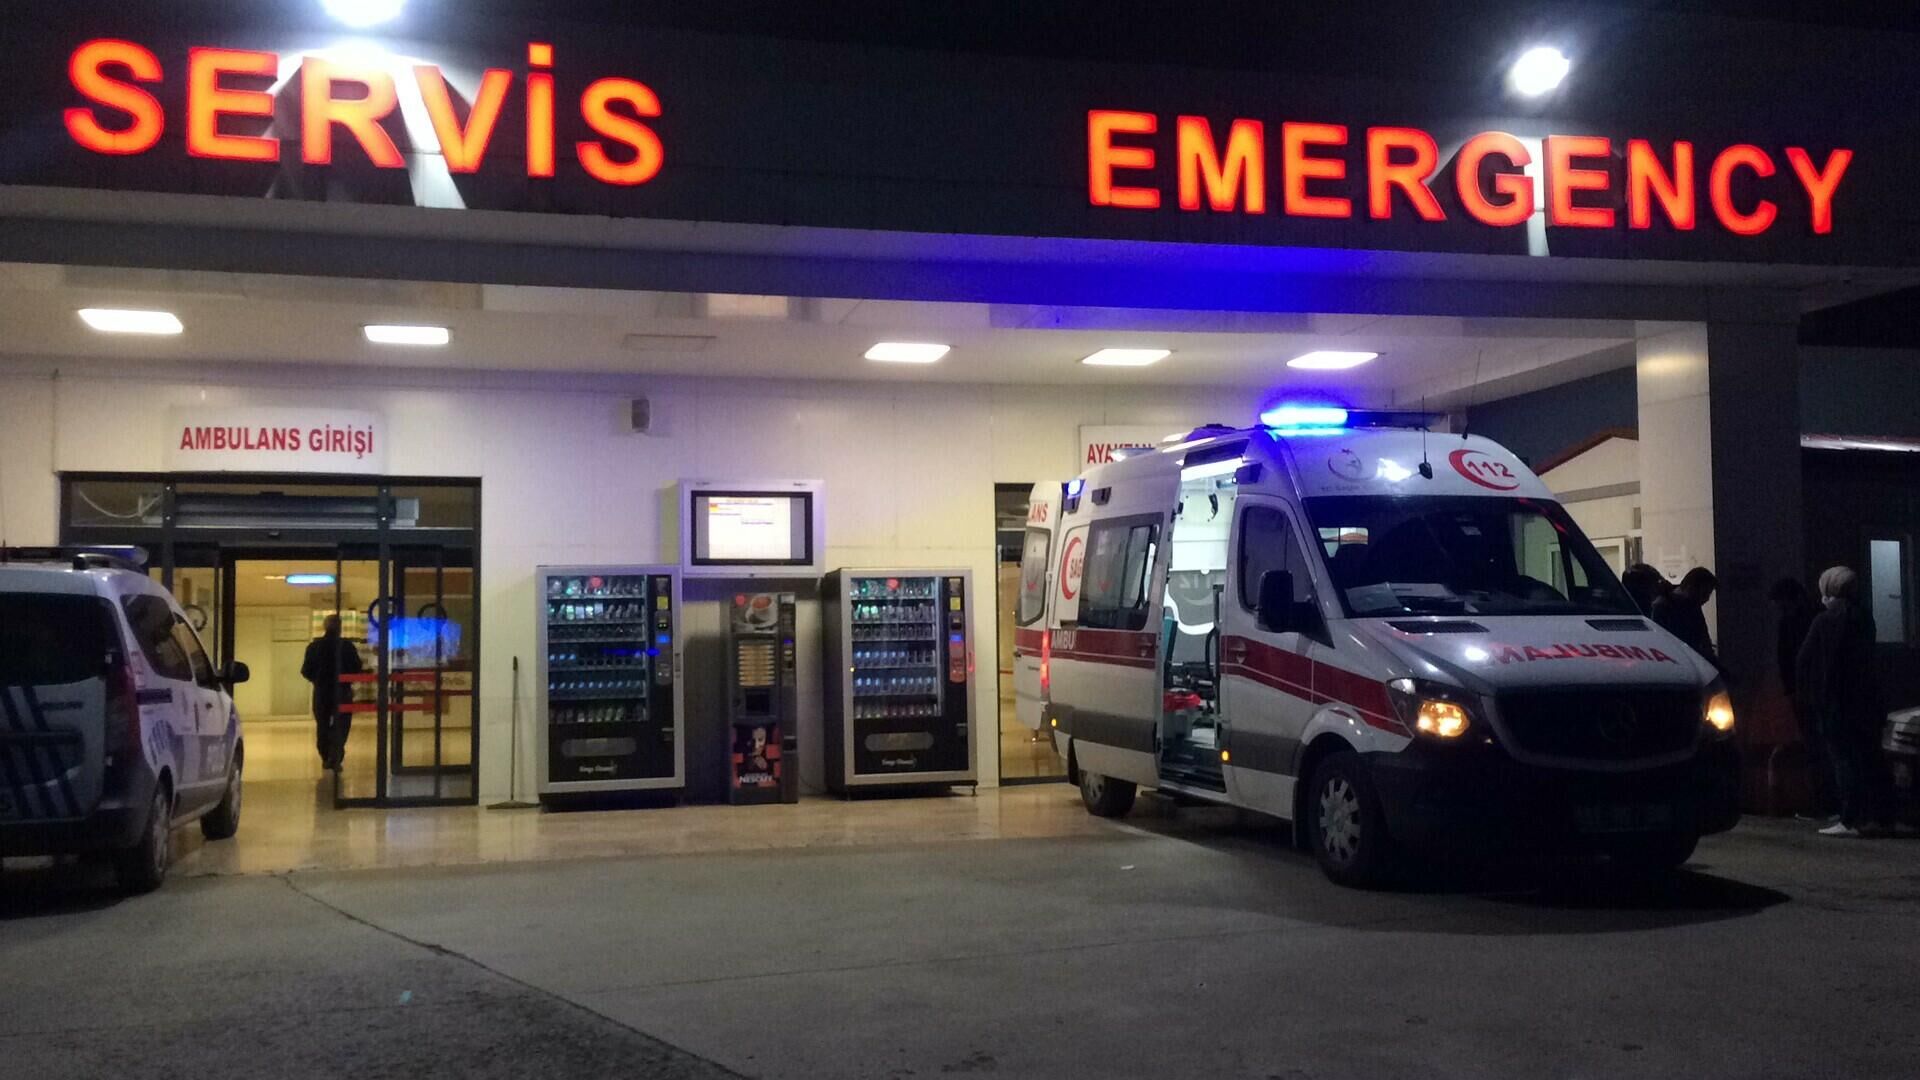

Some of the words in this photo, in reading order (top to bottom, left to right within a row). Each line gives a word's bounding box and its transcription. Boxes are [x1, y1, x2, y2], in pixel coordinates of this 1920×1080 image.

[63, 38, 664, 186] SERVİS
[1087, 109, 1854, 235] EMERGENCY
[180, 427, 302, 451] AMBULANS
[308, 424, 374, 459] GİRİŞİ
[1467, 460, 1515, 478] 112
